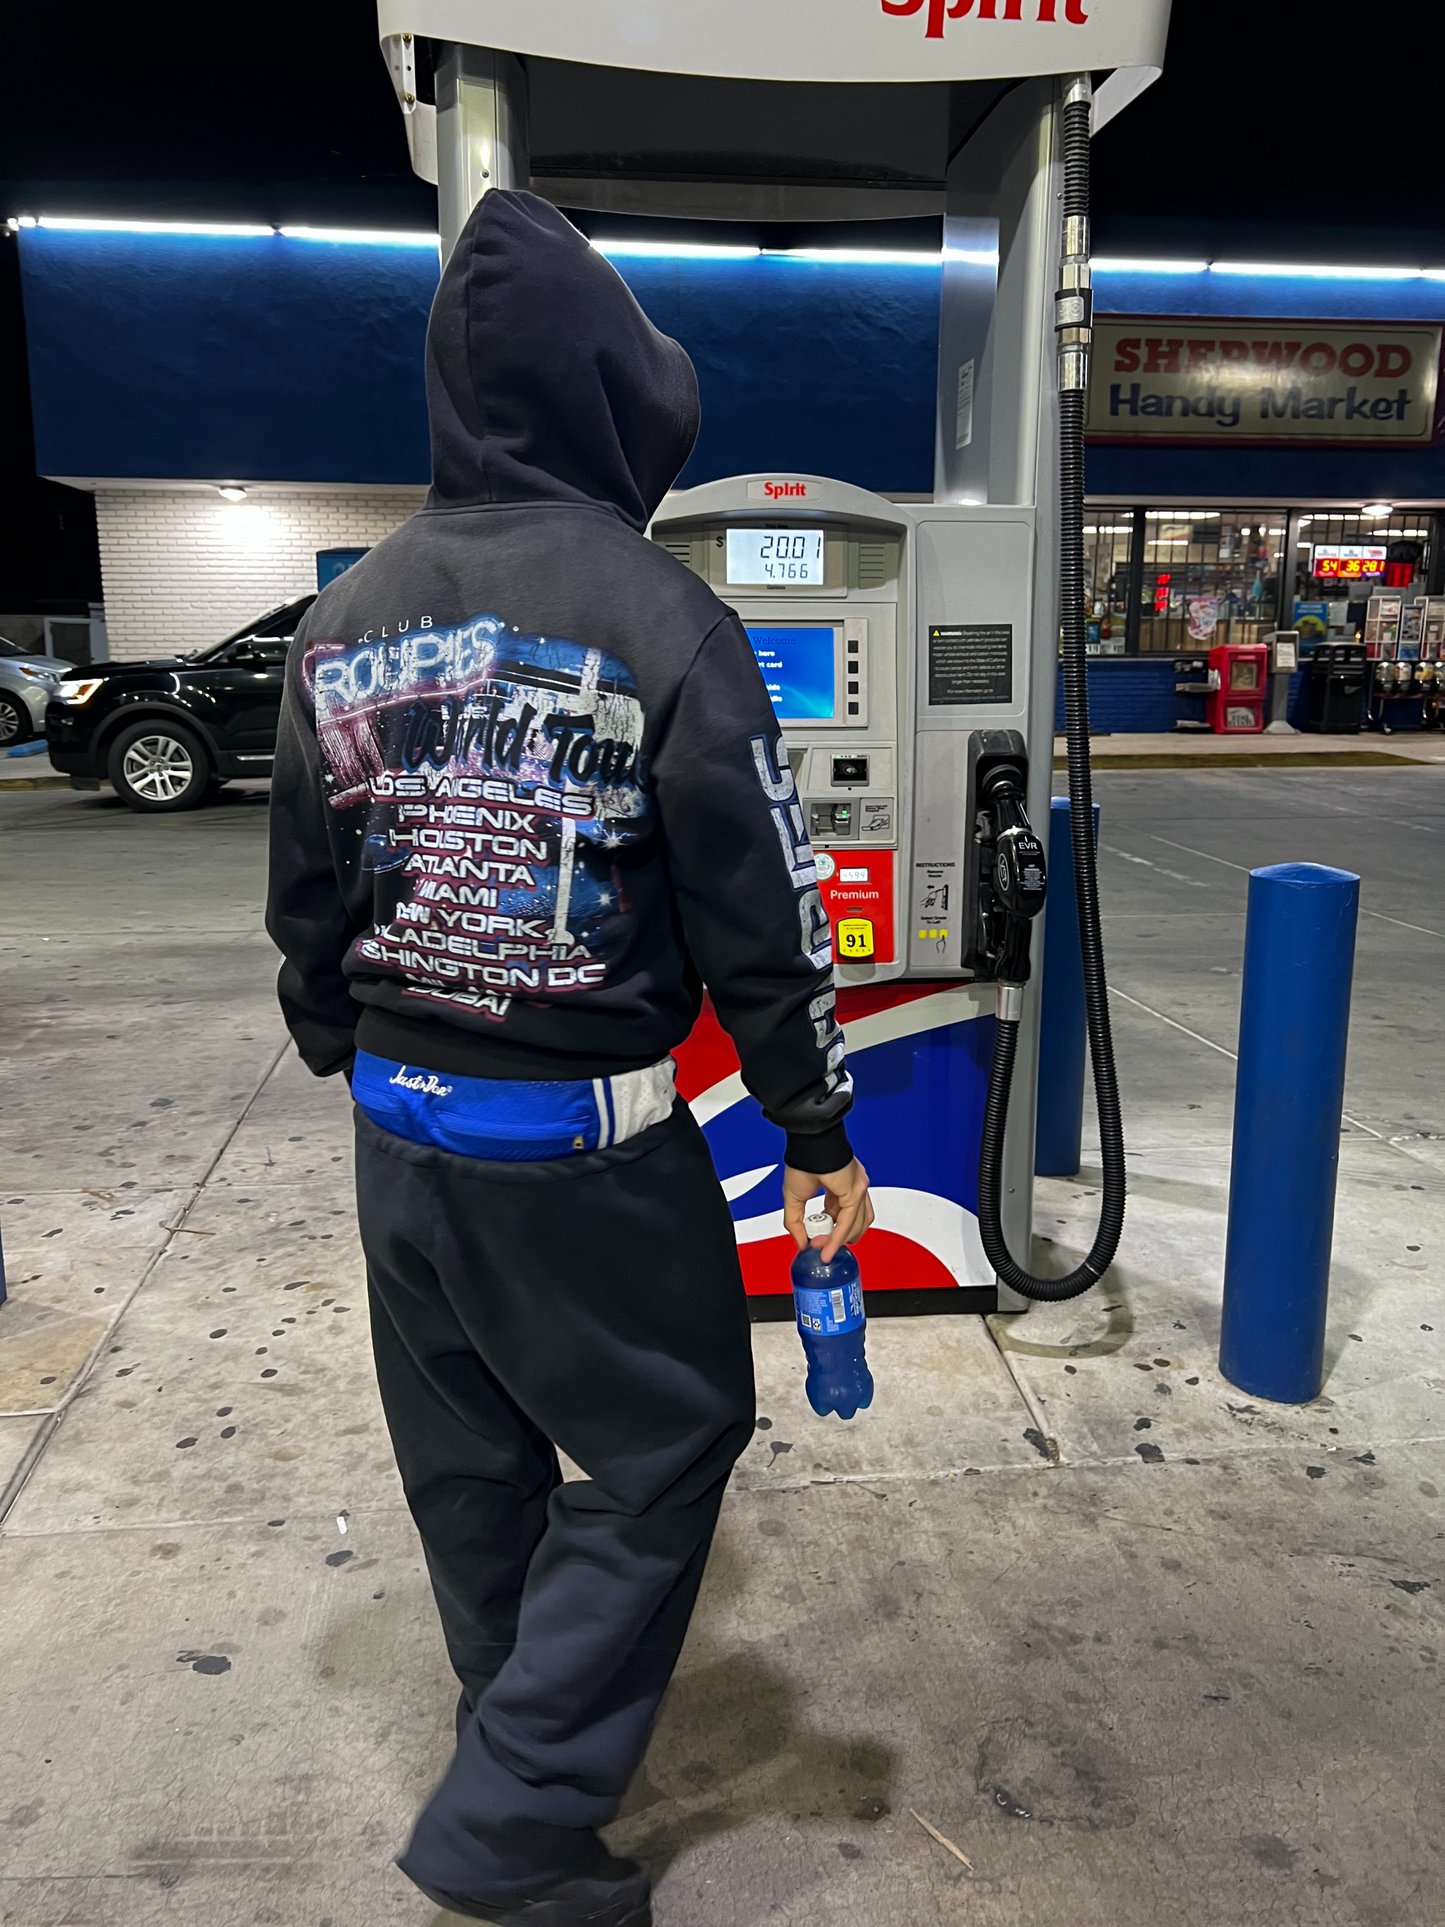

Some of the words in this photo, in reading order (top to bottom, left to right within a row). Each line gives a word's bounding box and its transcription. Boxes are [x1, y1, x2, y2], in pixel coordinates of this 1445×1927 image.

[1109, 383, 1241, 427] Handy
[1260, 387, 1412, 421] Market
[764, 482, 806, 499] Spirit
[760, 535, 821, 559] 20.01
[765, 563, 808, 578] 4.766
[363, 615, 433, 643] CLUB
[752, 636, 796, 645] Welcome
[1018, 842, 1038, 850] EVR
[830, 889, 880, 900] Premium
[436, 908, 547, 938] YORK
[845, 934, 867, 948] 91
[547, 963, 606, 986] DC
[389, 1065, 424, 1090] Just
